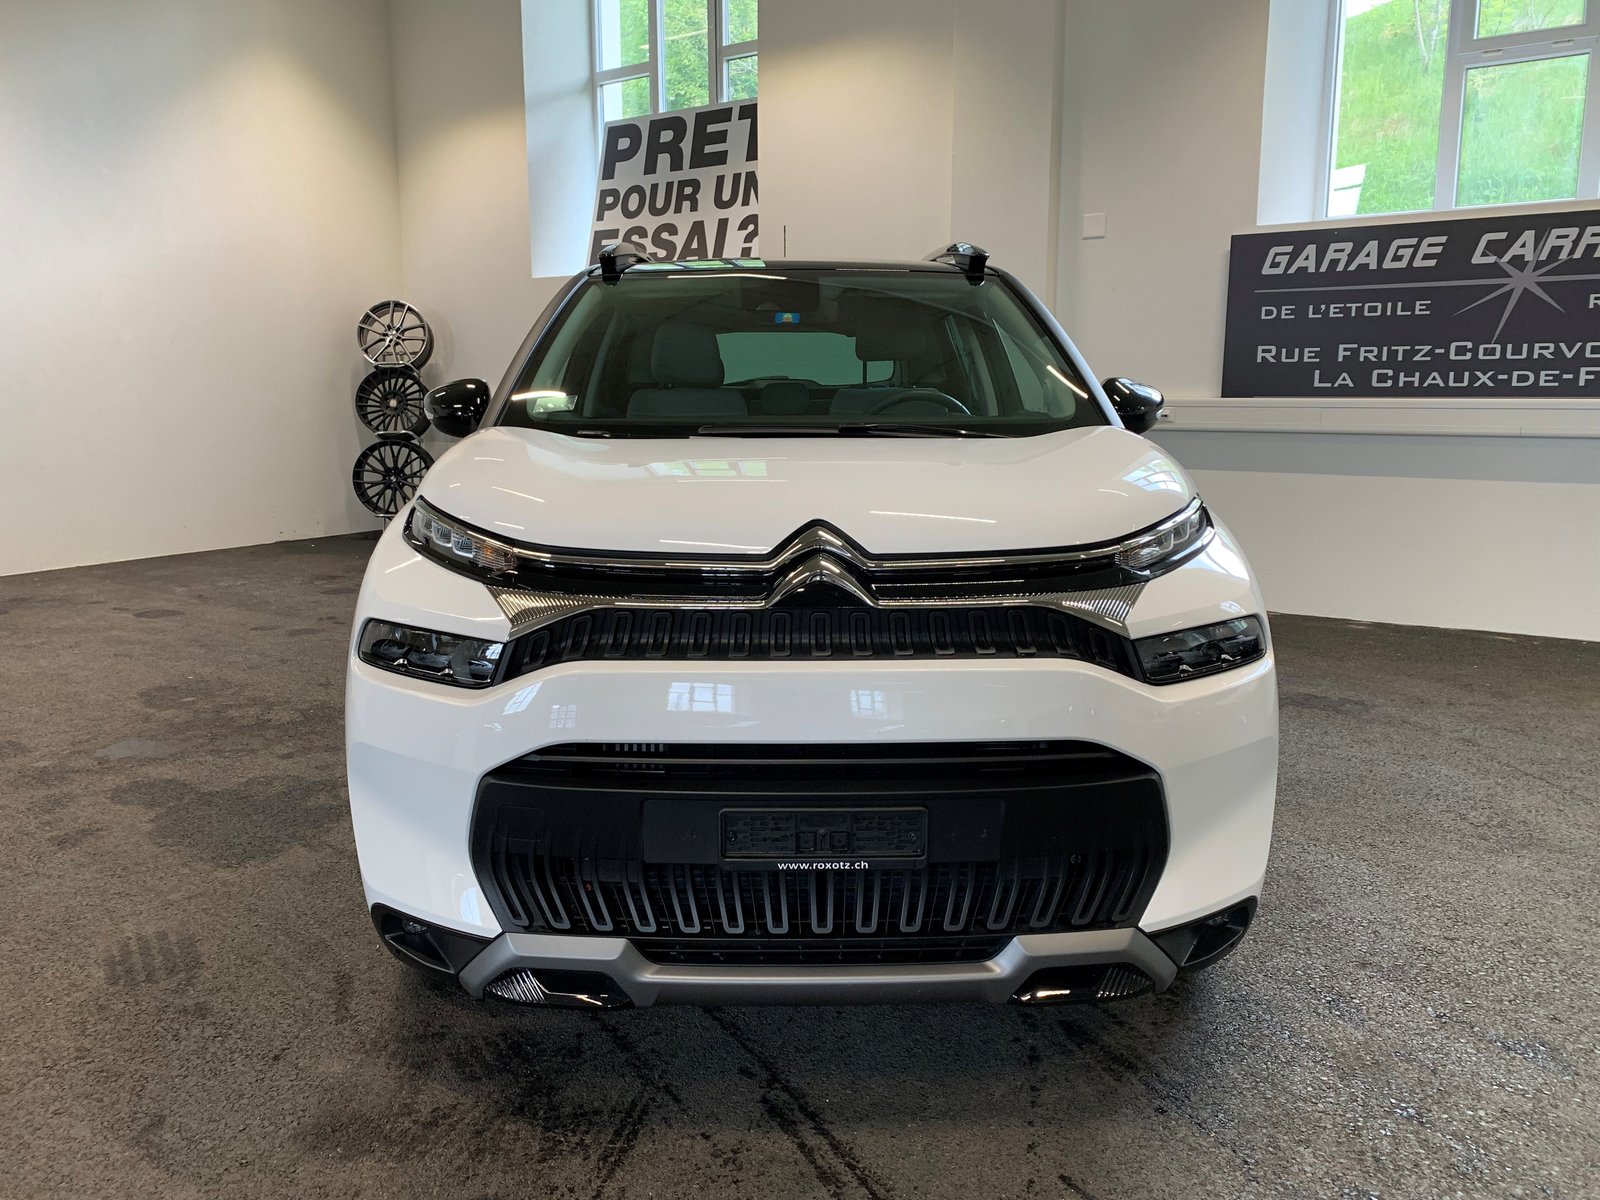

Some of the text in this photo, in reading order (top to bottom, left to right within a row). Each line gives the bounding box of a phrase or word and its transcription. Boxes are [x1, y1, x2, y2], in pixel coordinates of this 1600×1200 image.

[596, 178, 701, 222] POUR
[1260, 235, 1448, 275] GARAGE
[1260, 301, 1432, 320] DE L'ETOILE
[777, 860, 869, 870] www.roxotz.ch
